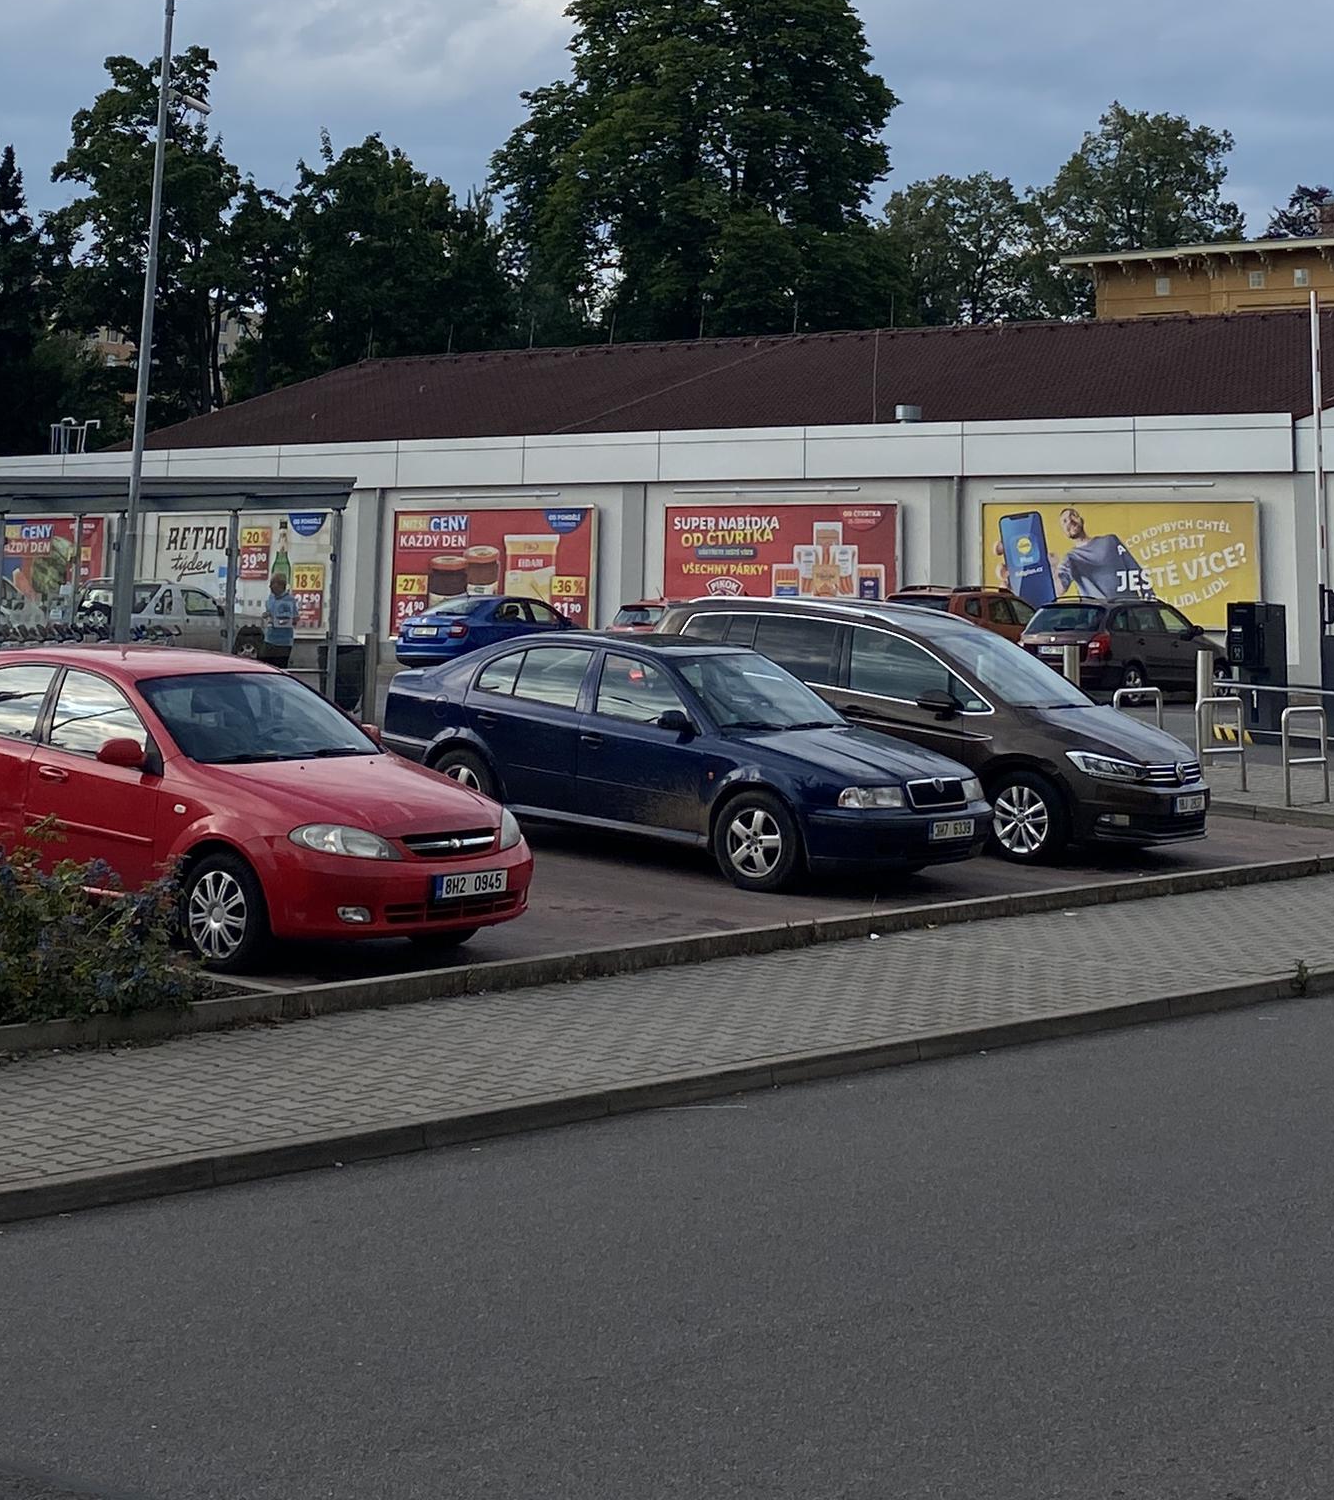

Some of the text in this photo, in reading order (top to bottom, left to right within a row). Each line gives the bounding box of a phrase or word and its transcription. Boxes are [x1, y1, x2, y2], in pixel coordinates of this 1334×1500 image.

[22, 524, 52, 539] CENY
[430, 515, 468, 532] CENY
[673, 514, 780, 531] SUPER NABÍDKA
[1142, 519, 1193, 541] KDYBYCH
[1196, 519, 1232, 534] CHTĚL
[30, 541, 51, 554] DEN
[166, 526, 228, 551] RETRO
[441, 535, 467, 548] DEN
[681, 527, 774, 548] OD ČTVRTKA
[1139, 533, 1206, 561] UŠETŘIT
[171, 551, 215, 582] týden
[682, 562, 729, 575] VŠECHNY
[1116, 542, 1249, 593] JEŠTĚ VÍCE?
[1202, 576, 1230, 600] LIDL
[445, 873, 503, 894] 8H2 0945
